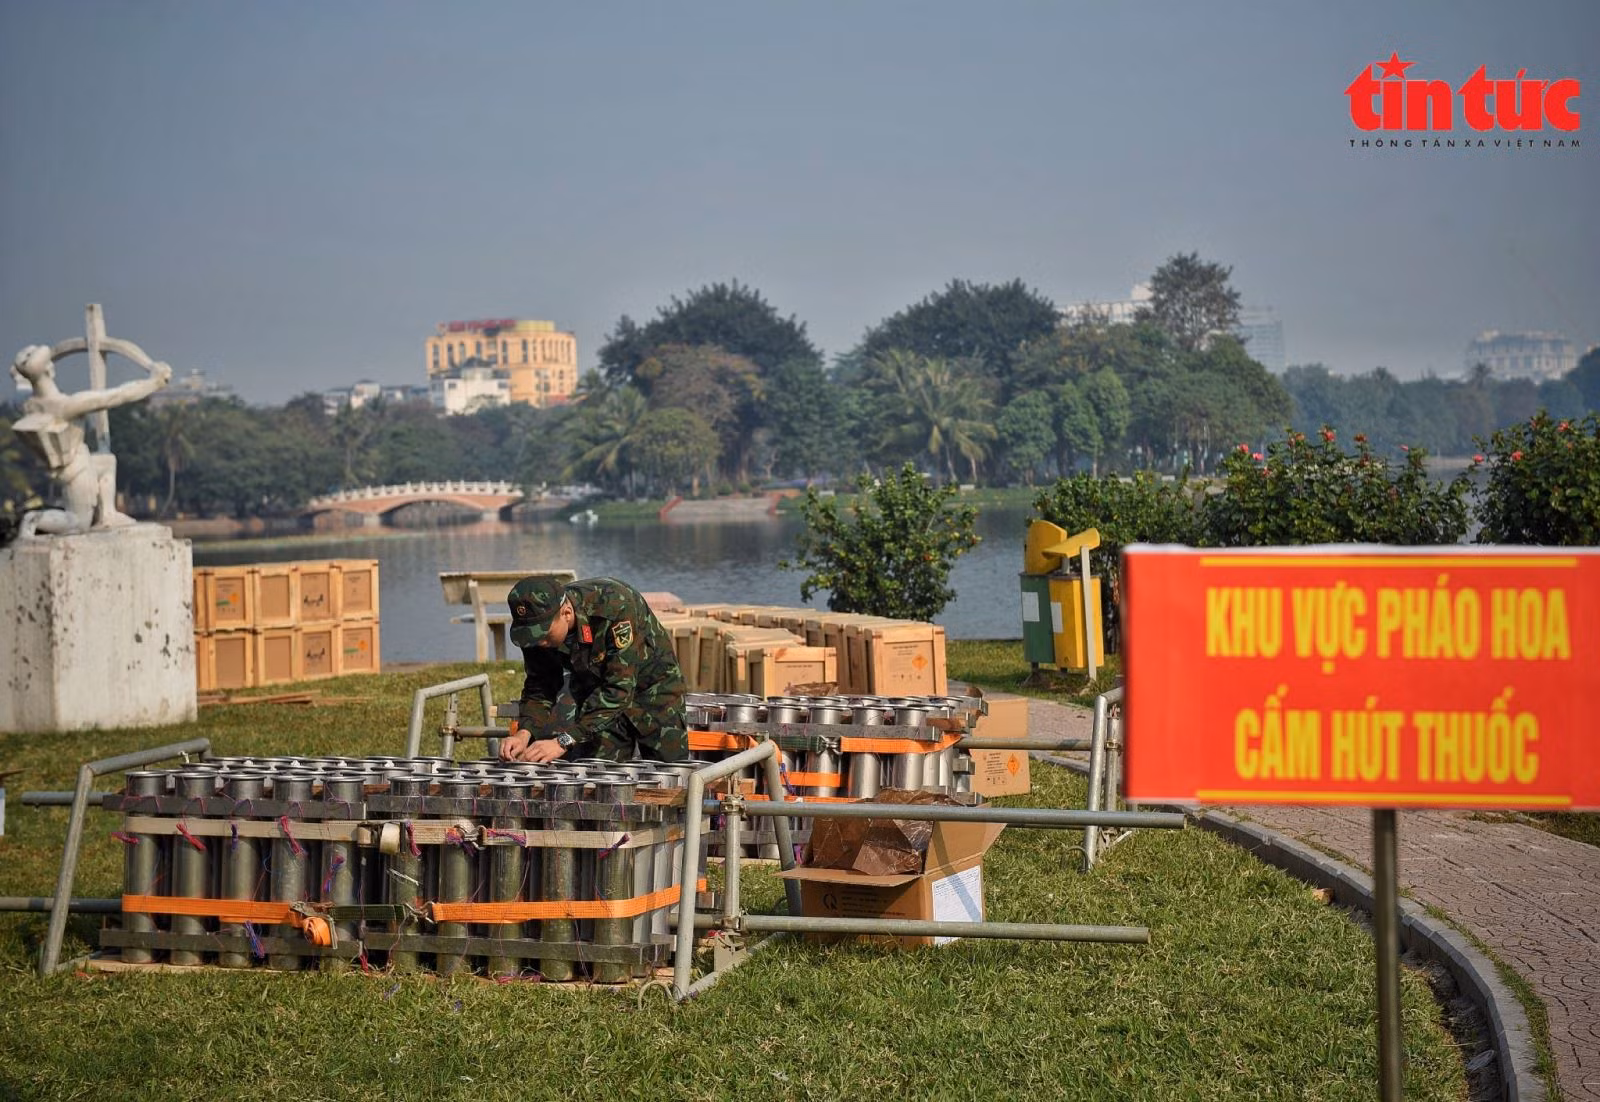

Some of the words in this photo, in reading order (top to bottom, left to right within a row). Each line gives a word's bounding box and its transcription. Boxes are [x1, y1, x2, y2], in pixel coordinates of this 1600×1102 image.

[1206, 586, 1282, 657] KHU
[1292, 579, 1367, 674] VỰC
[1377, 574, 1481, 660] PHÁO
[1491, 587, 1571, 660] HOA
[1234, 684, 1322, 780] CẤM
[1331, 696, 1404, 782] HÚT
[1413, 686, 1539, 784] THUỐC
